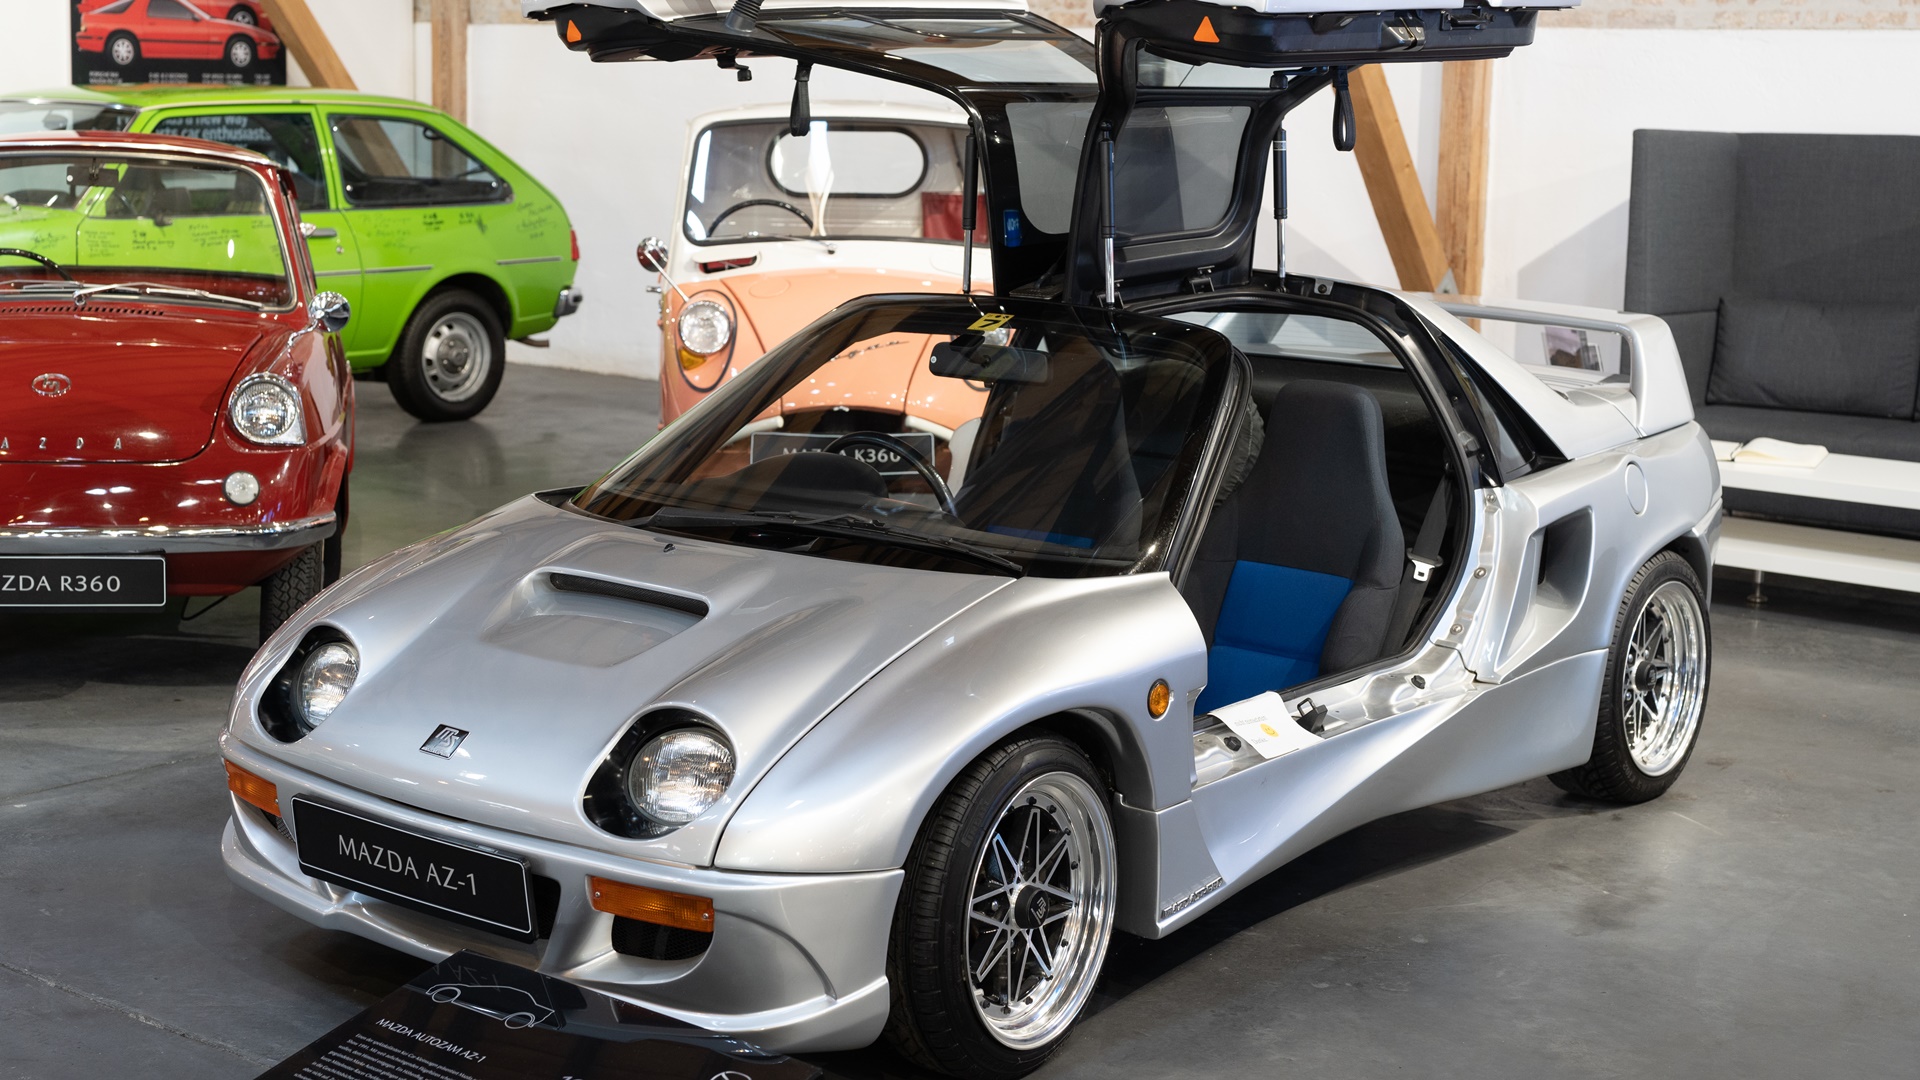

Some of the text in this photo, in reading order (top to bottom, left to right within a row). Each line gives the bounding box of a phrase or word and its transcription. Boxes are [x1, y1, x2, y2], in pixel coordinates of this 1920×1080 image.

[854, 448, 902, 464] K360
[60, 574, 121, 593] R360
[338, 834, 477, 896] MAZDA AZ-1
[375, 1018, 414, 1037] MAZDA
[410, 1031, 465, 1055] AUTOZAM
[459, 1048, 487, 1064] AZ-1
